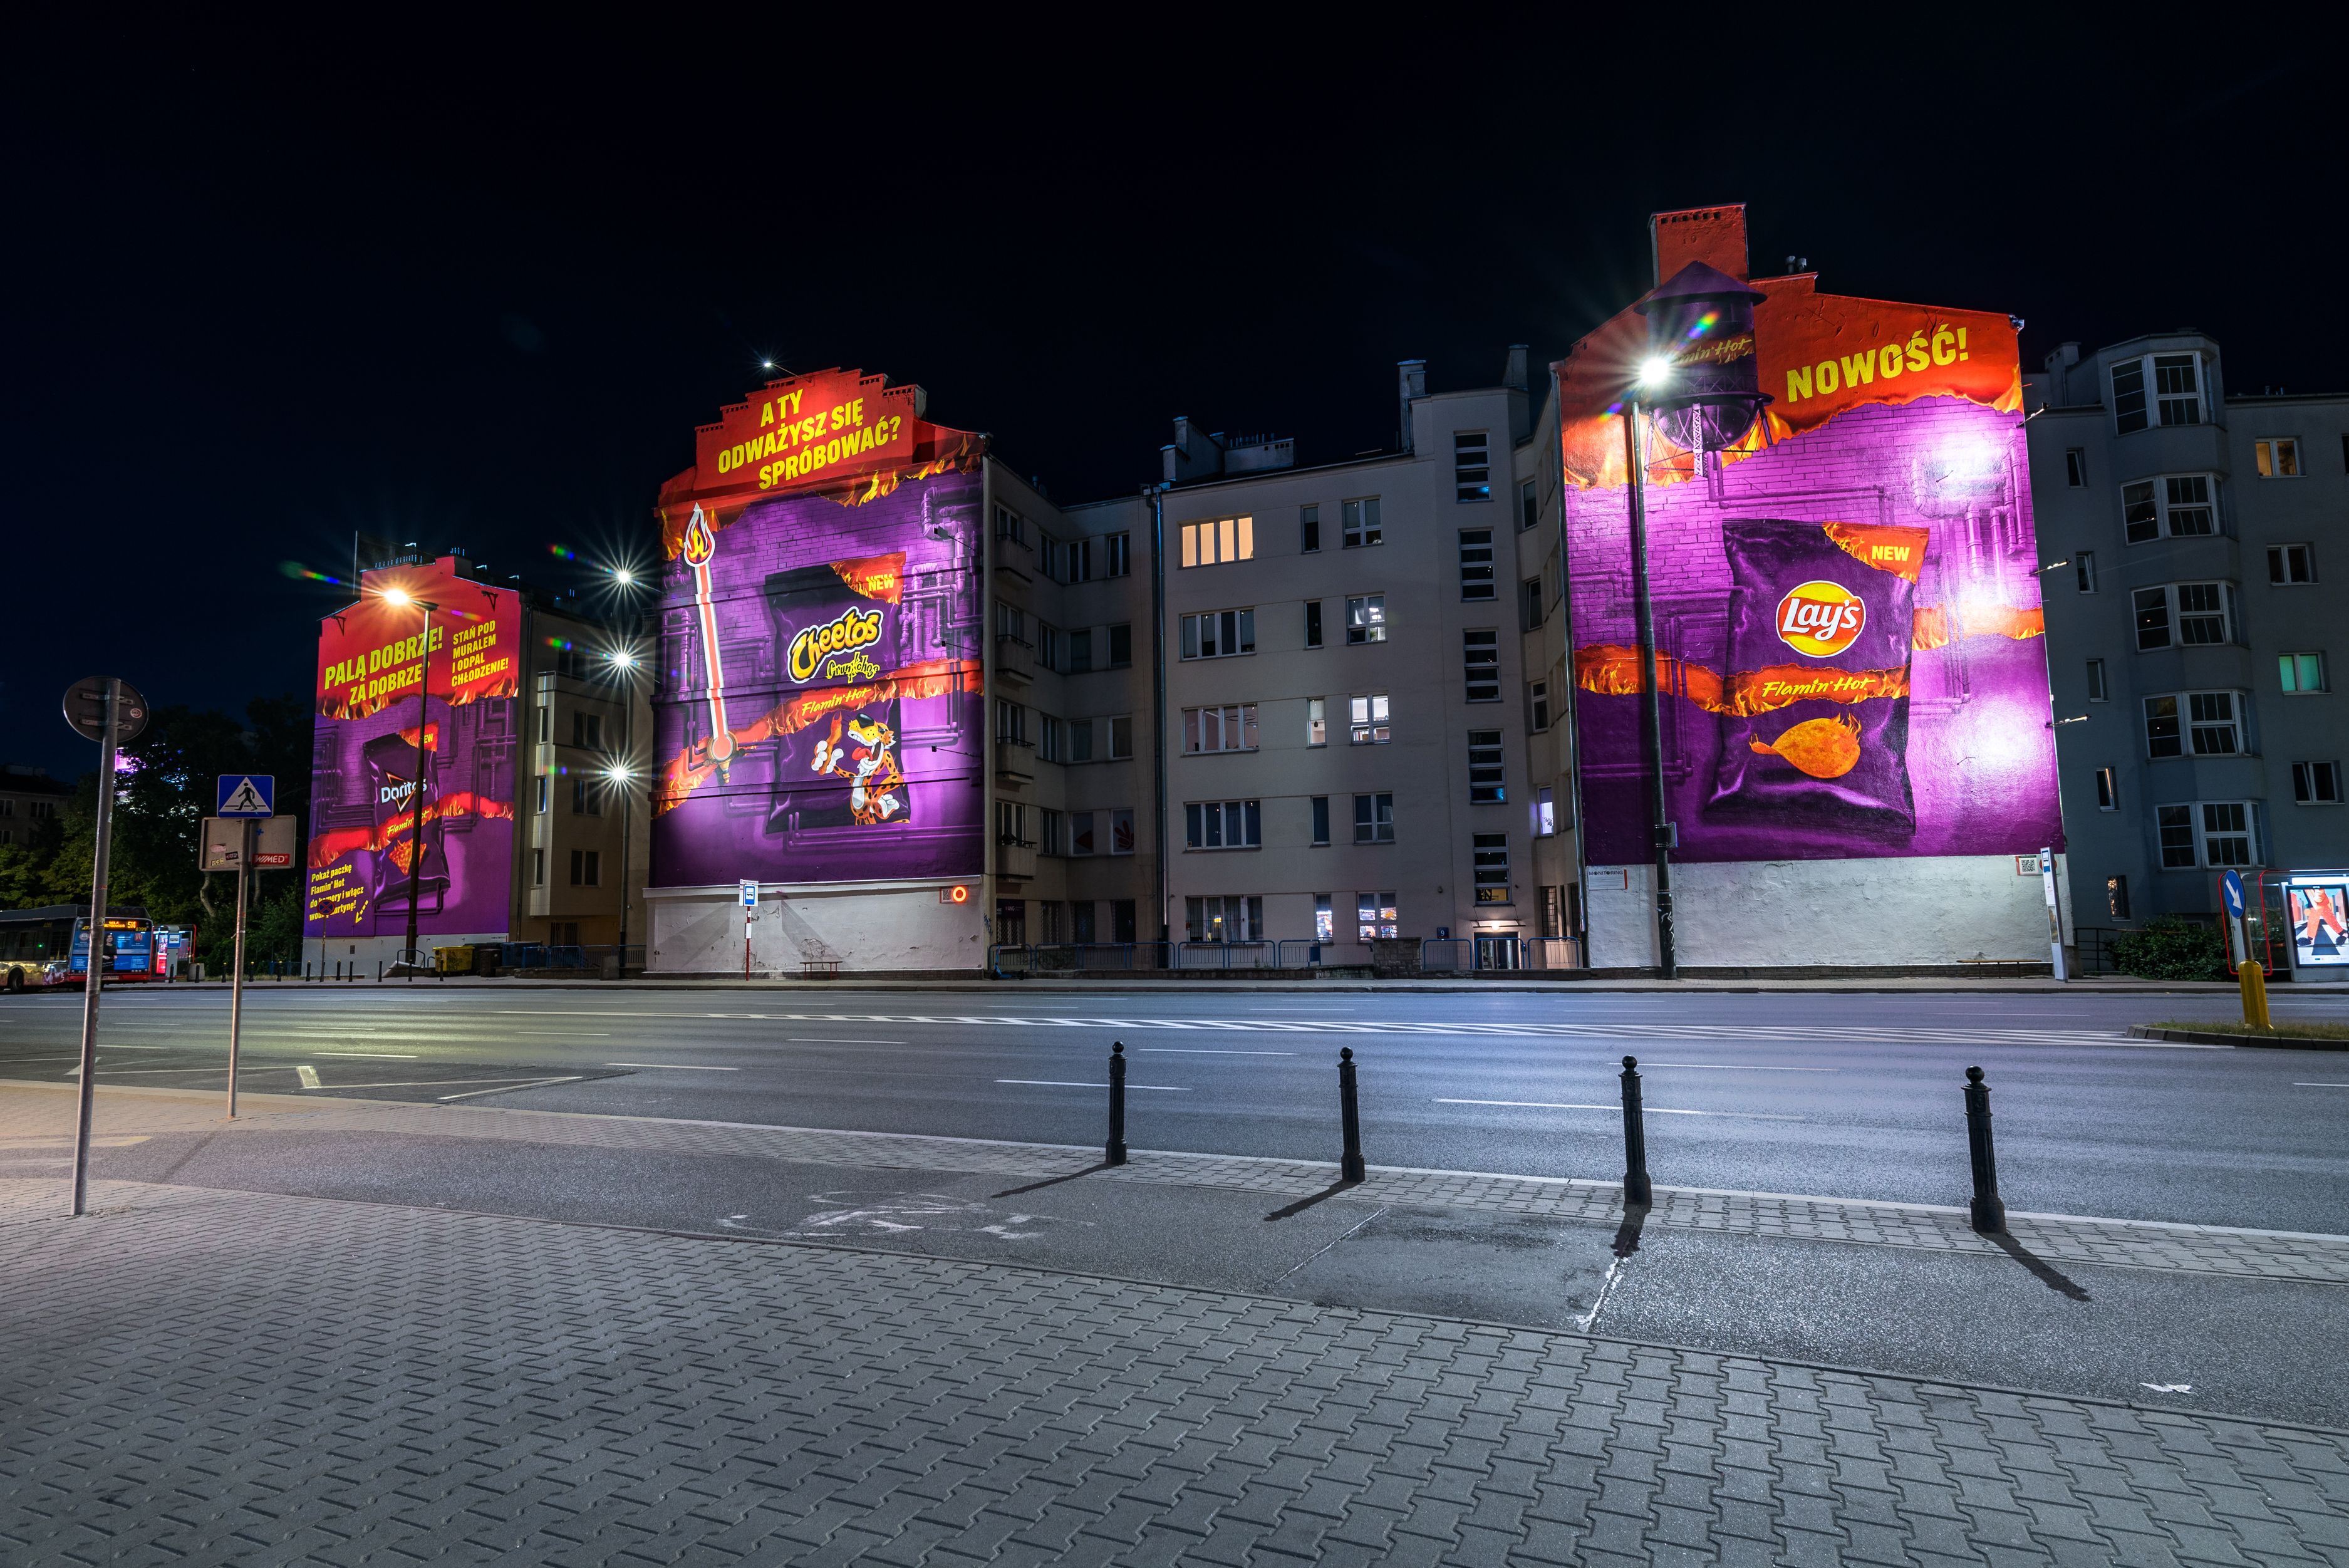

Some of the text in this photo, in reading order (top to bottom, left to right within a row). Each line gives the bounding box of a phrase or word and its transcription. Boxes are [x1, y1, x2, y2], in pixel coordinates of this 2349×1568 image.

[1715, 338, 1752, 356] Hot
[1786, 323, 1969, 403] NOWOŚĆ!
[760, 388, 803, 427] A TY
[718, 397, 863, 474] ODWAŻYSZ SIĘ
[759, 415, 901, 490] SPRÓBOWAĆ?
[1872, 546, 1910, 561] NEW
[866, 573, 894, 591] NEW
[1782, 598, 1860, 641] Lay's
[453, 620, 495, 645] STAŃ POD
[453, 633, 496, 659] MURALEM
[791, 610, 879, 680] Cheetos
[324, 626, 443, 690] PALĄ DOBRZE!
[452, 652, 485, 673] I ODPAL
[451, 657, 509, 687] CHŁODZENIE!
[349, 683, 366, 706] ZA
[1762, 677, 1876, 697] Flamin' Hot
[802, 688, 871, 716] Flamin' Hot
[424, 733, 433, 744] EW
[387, 817, 414, 837] Flamin'
[311, 864, 352, 883] Pokaż paczkę
[309, 886, 364, 908] do kmery i włącz
[311, 878, 345, 895] Flamin' Hot
[330, 900, 356, 916] urtynę!
